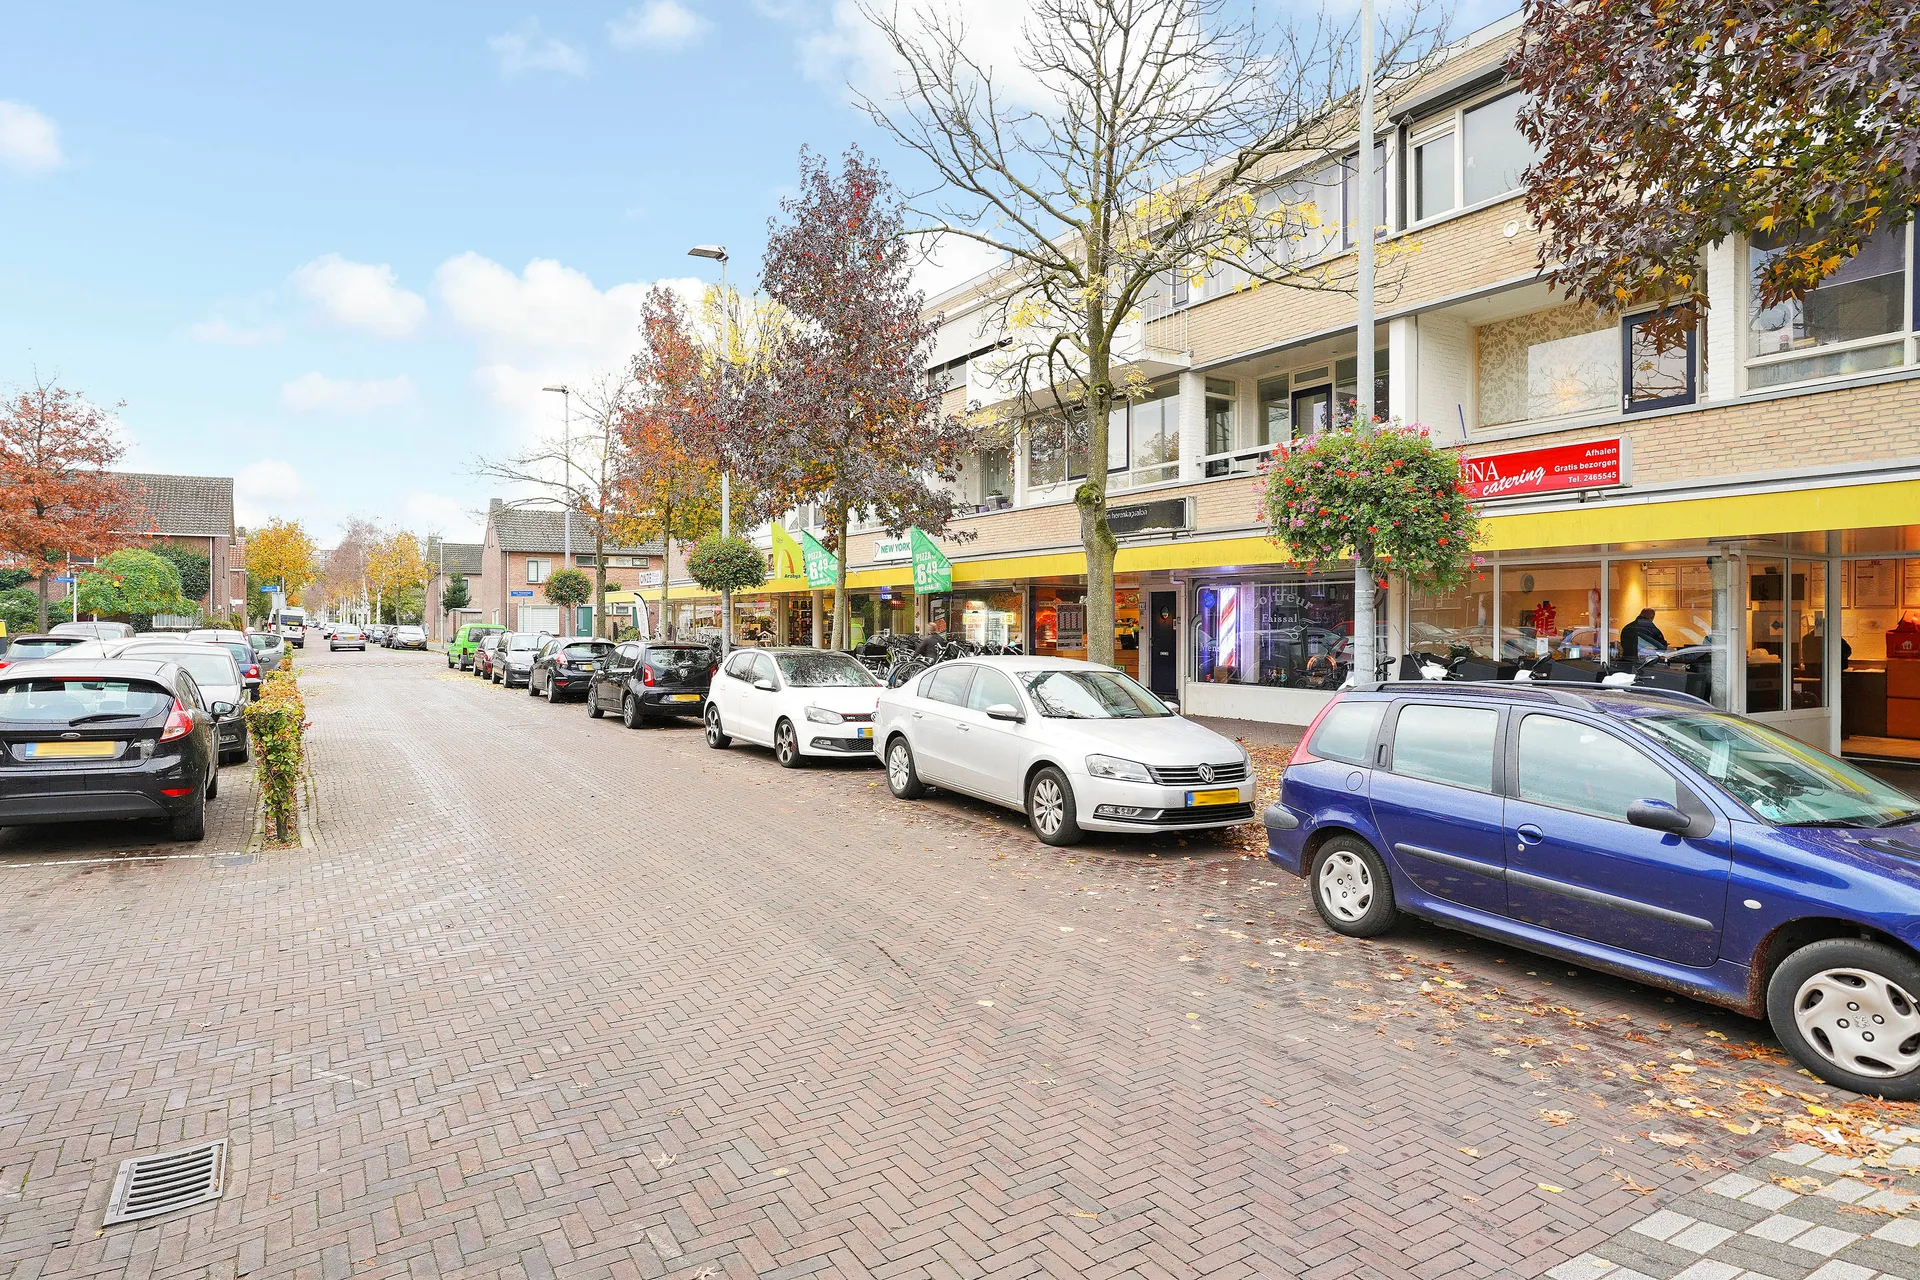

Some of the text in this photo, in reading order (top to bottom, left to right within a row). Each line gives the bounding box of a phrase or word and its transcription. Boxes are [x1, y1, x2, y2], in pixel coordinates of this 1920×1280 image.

[1585, 447, 1617, 457] Afhalen
[1554, 459, 1617, 473] Gratis bezorgen
[1457, 461, 1500, 484] INA
[1568, 472, 1617, 484] Tel. 2465545
[1482, 465, 1546, 497] catering
[880, 542, 911, 553] NEW YORK
[807, 551, 823, 560] PIZZA
[915, 551, 932, 562] PIZZA
[1261, 613, 1298, 623] Faissal
